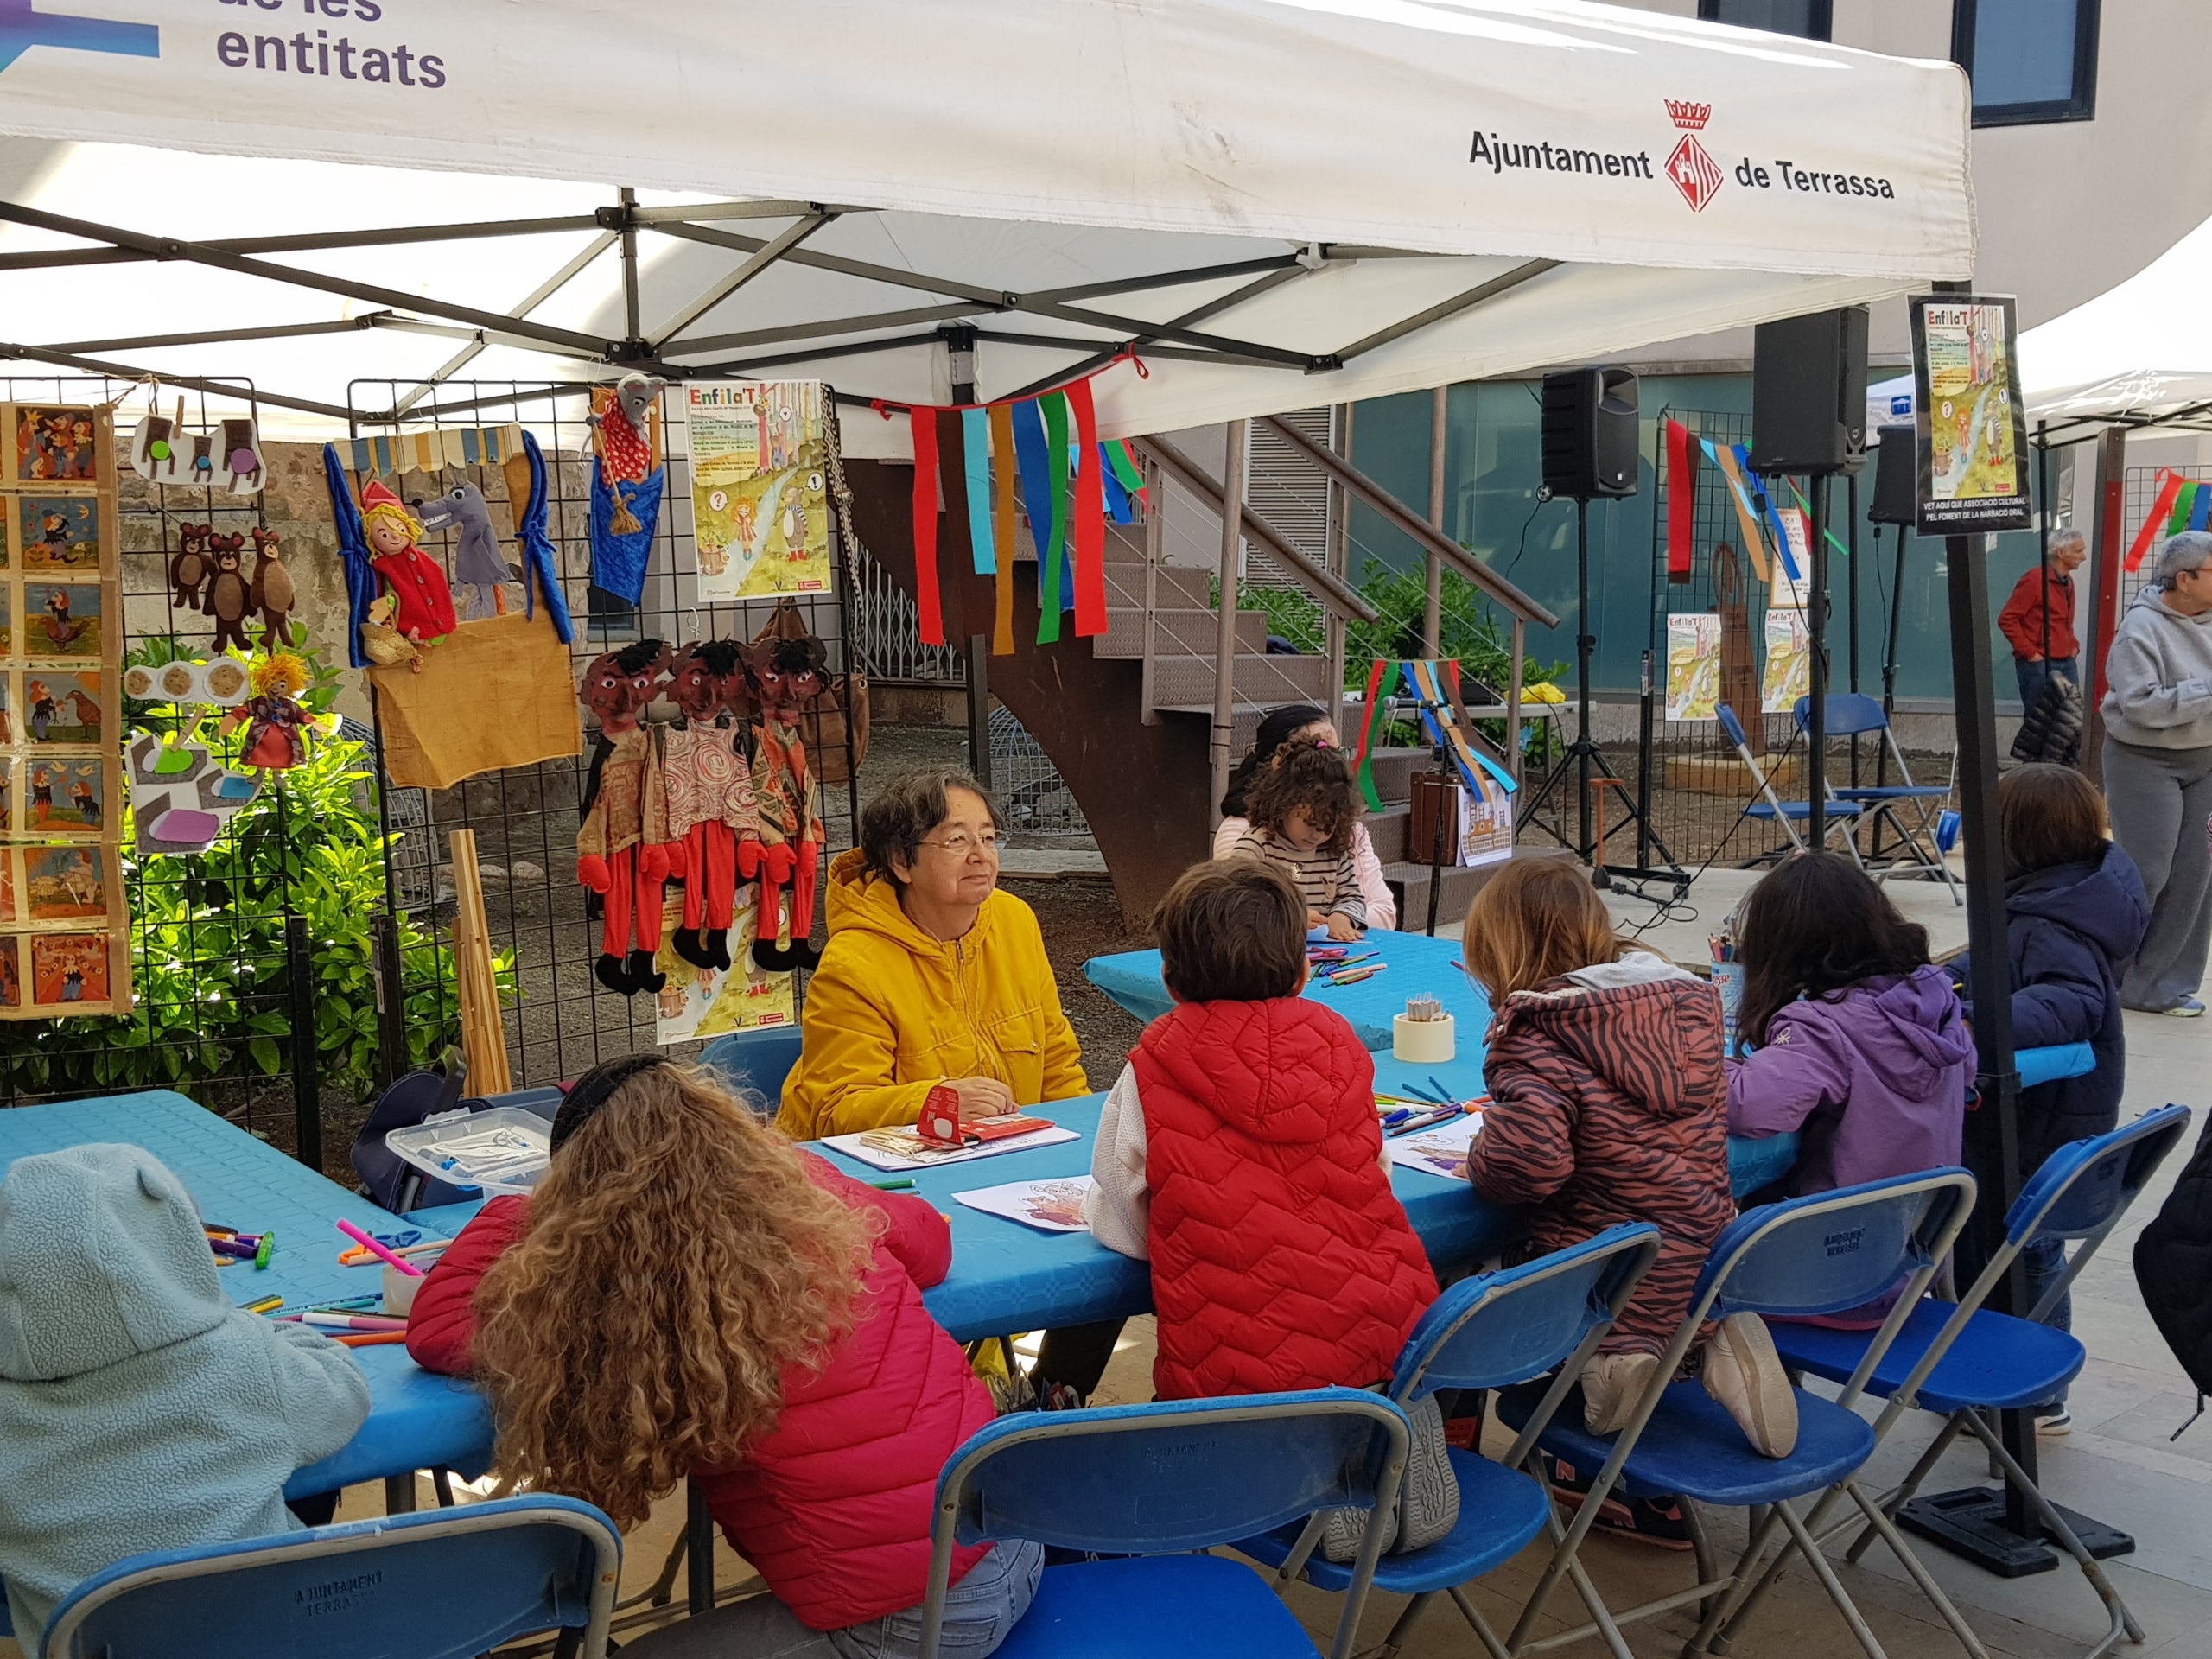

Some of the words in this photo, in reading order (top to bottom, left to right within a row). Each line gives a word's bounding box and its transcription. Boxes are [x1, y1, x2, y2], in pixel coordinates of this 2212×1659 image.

[217, 29, 446, 89] entitats
[1469, 130, 1654, 179] Ajuntament
[1734, 157, 1770, 188] de
[1775, 160, 1896, 200] Terrassa
[690, 387, 755, 405] Enfila'T
[1923, 502, 1936, 511] VET
[1999, 497, 2025, 505] CULTURAL
[1926, 513, 1937, 522] PEL
[1938, 512, 1961, 520] FOMENT
[2009, 507, 2024, 516] ORAL
